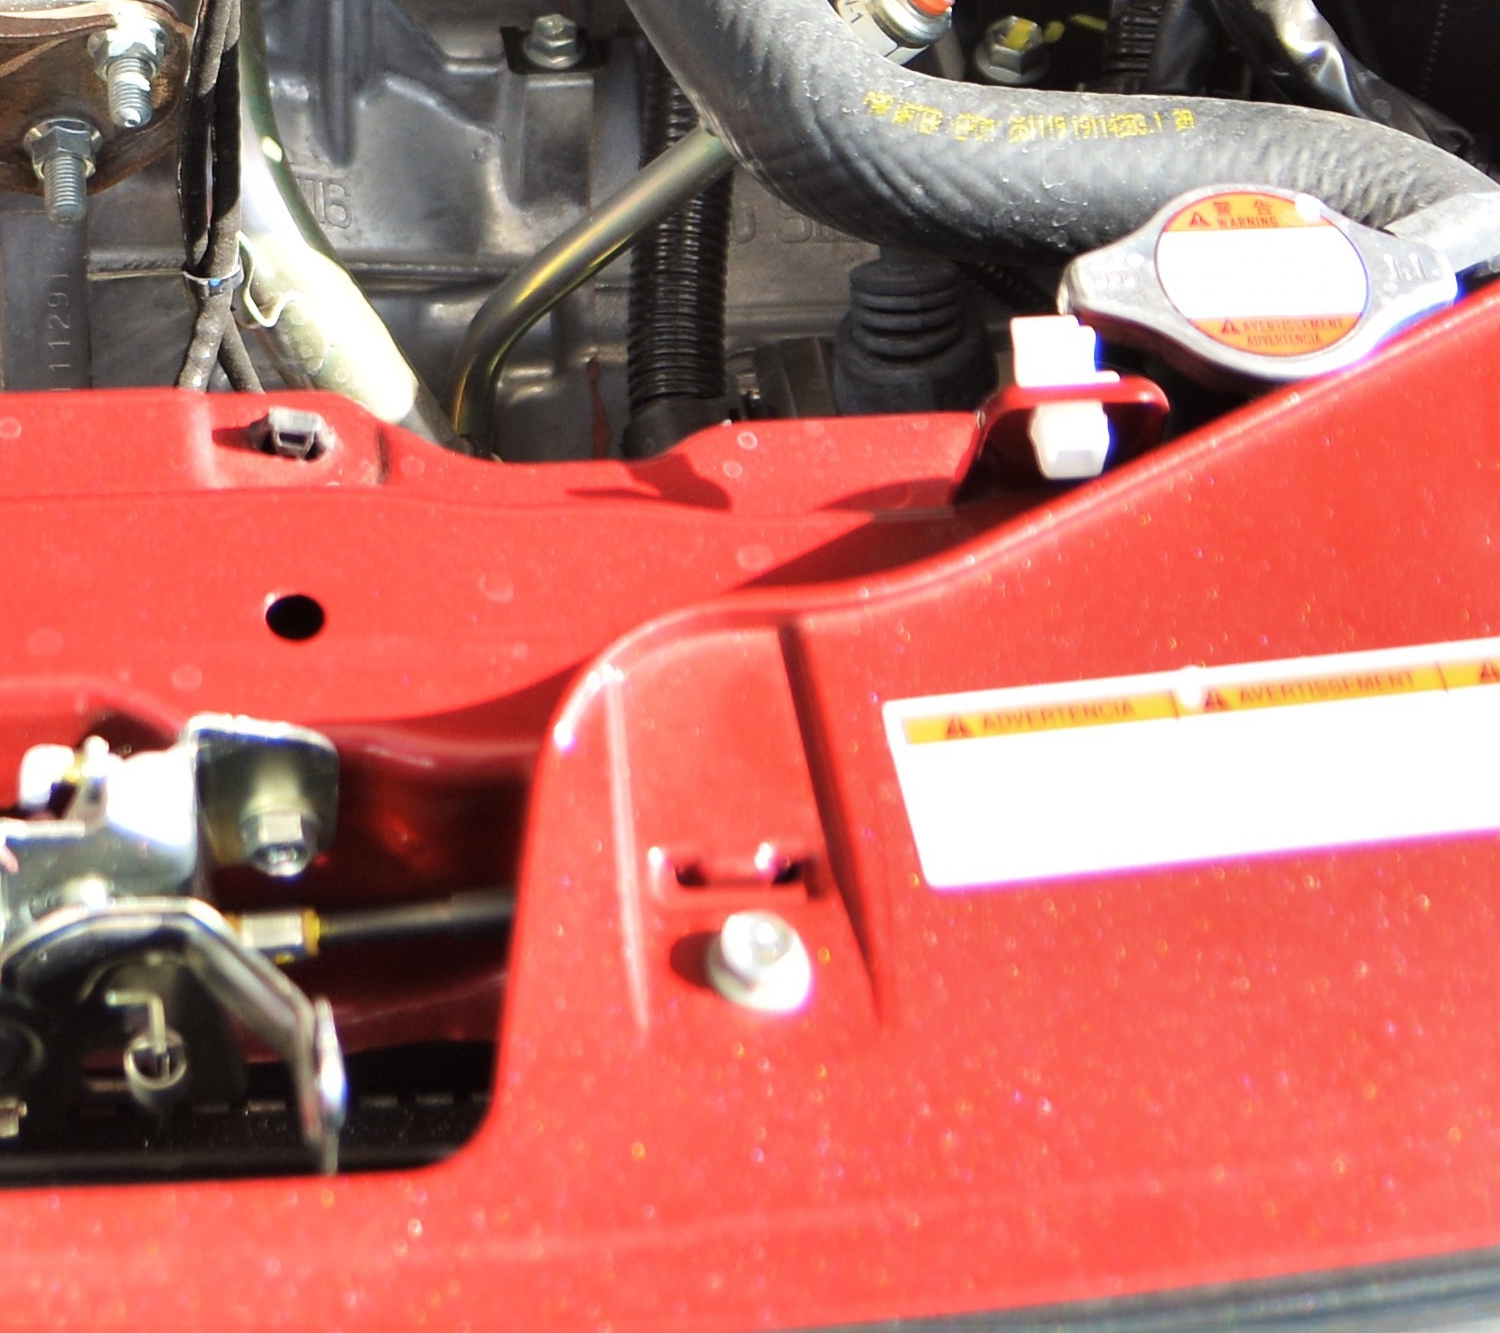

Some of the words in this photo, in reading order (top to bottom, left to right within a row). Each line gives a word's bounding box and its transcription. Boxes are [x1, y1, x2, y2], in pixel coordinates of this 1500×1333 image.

[1216, 216, 1279, 230] WARNING
[1243, 317, 1344, 333] AVERTISSEMENT
[1247, 333, 1323, 347] ADVERTENCIA
[982, 699, 1137, 732] ADVERTENCIA
[1238, 670, 1418, 705] AVERTISSEMENT
